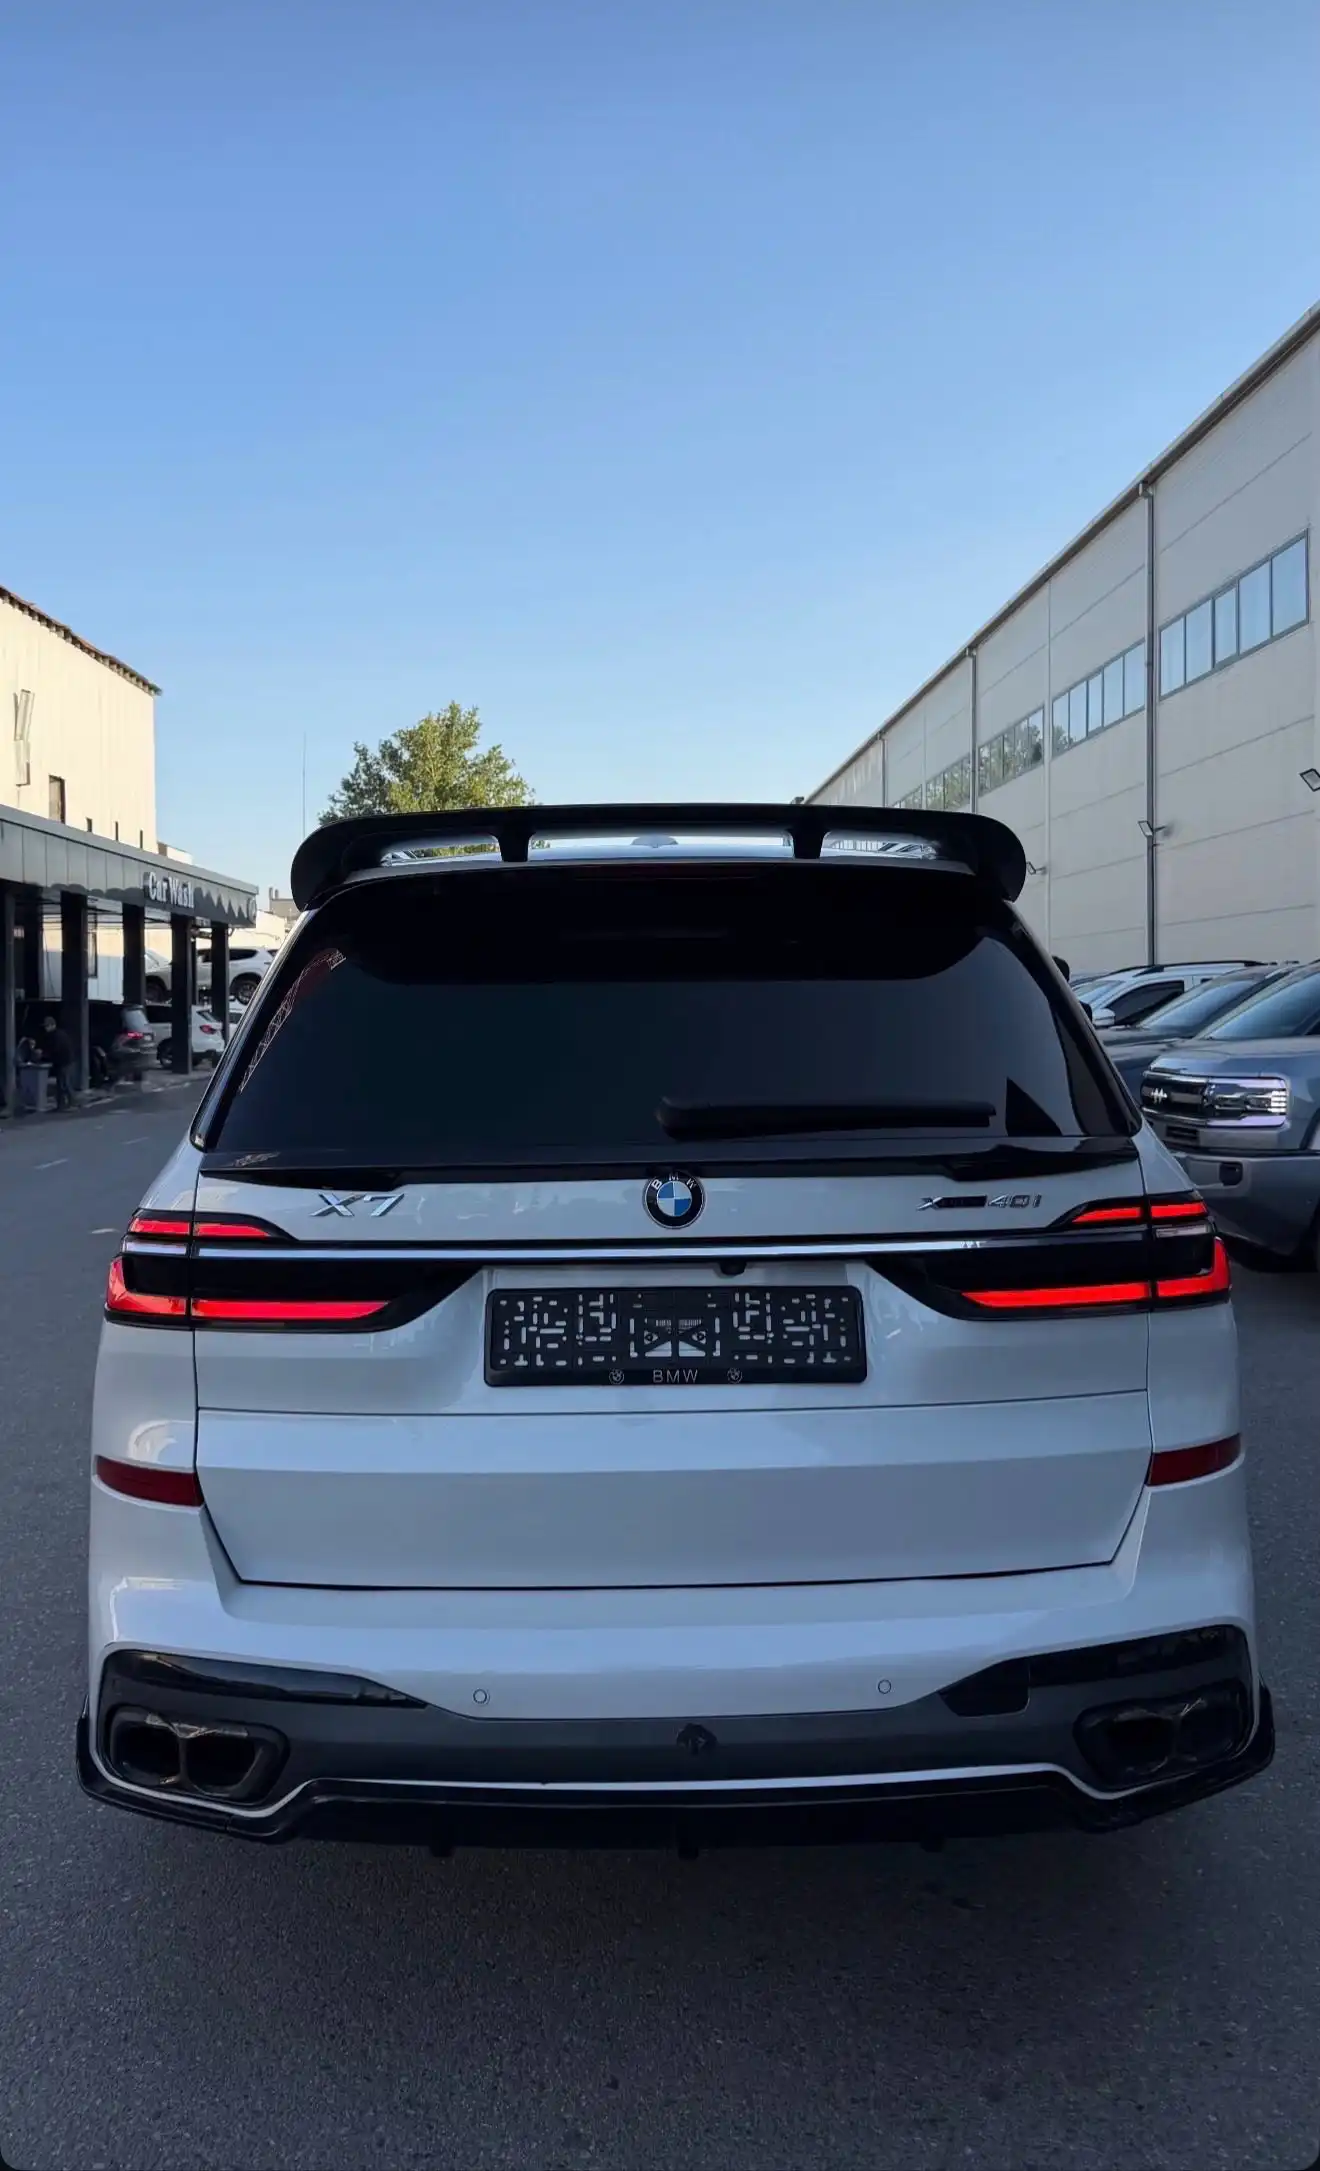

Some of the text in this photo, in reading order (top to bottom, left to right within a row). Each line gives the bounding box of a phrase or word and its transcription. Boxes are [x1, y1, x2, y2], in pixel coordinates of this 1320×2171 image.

[149, 872, 194, 908] Car Wash
[651, 1172, 697, 1190] BMW
[310, 1193, 404, 1216] X7
[652, 1369, 698, 1383] BMW
